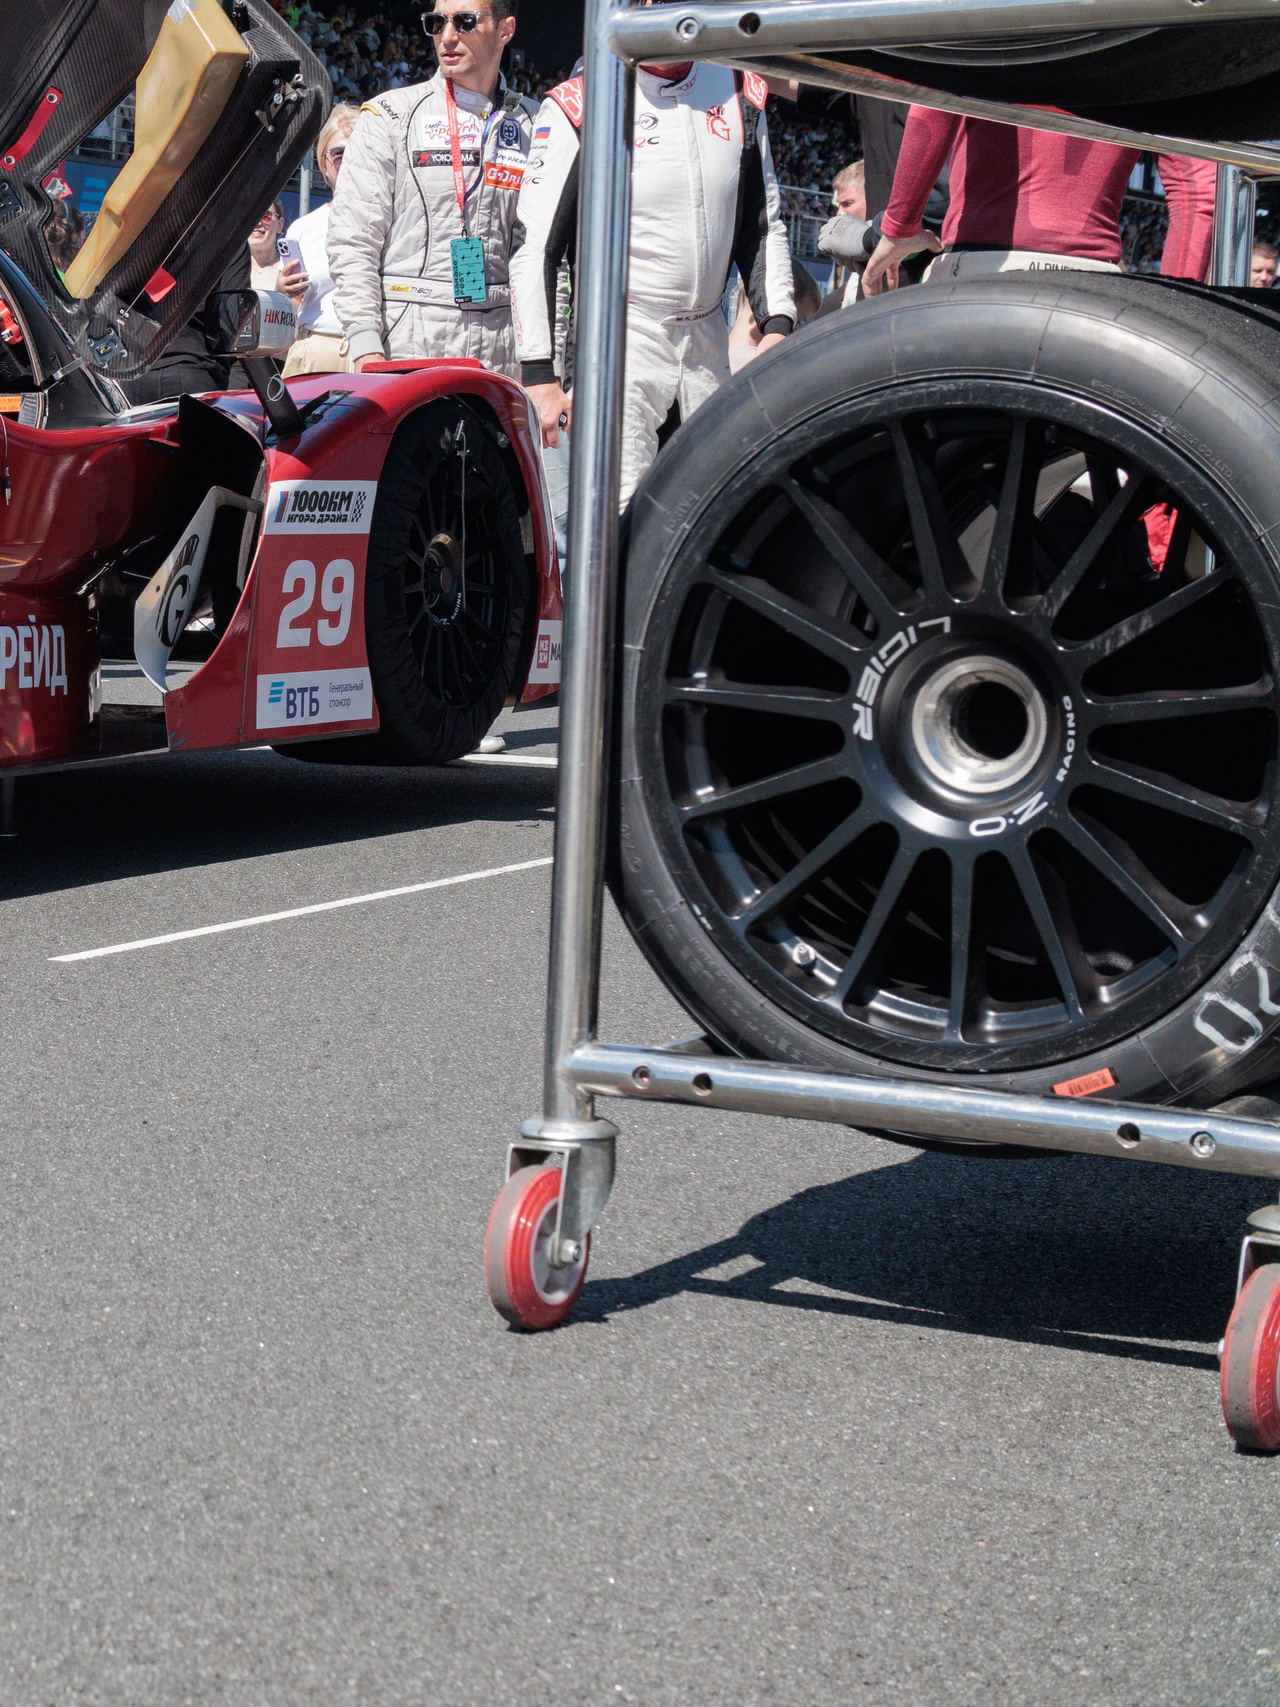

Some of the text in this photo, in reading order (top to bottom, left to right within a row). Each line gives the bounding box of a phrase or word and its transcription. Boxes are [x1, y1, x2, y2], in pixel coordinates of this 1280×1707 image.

[377, 99, 400, 120] Sabelt
[430, 152, 475, 162] YOKOMA
[507, 155, 528, 166] RACIN
[264, 308, 296, 329] HIKROB
[286, 511, 349, 524] ИГОРА ДРАЙВ
[276, 558, 355, 649] 29
[450, 592, 462, 621] RACING
[328, 679, 365, 696] Генеральный
[851, 615, 952, 742] LIGIER
[285, 685, 320, 719] ВТБ
[328, 696, 352, 710] спонсор
[1055, 695, 1076, 783] RACING
